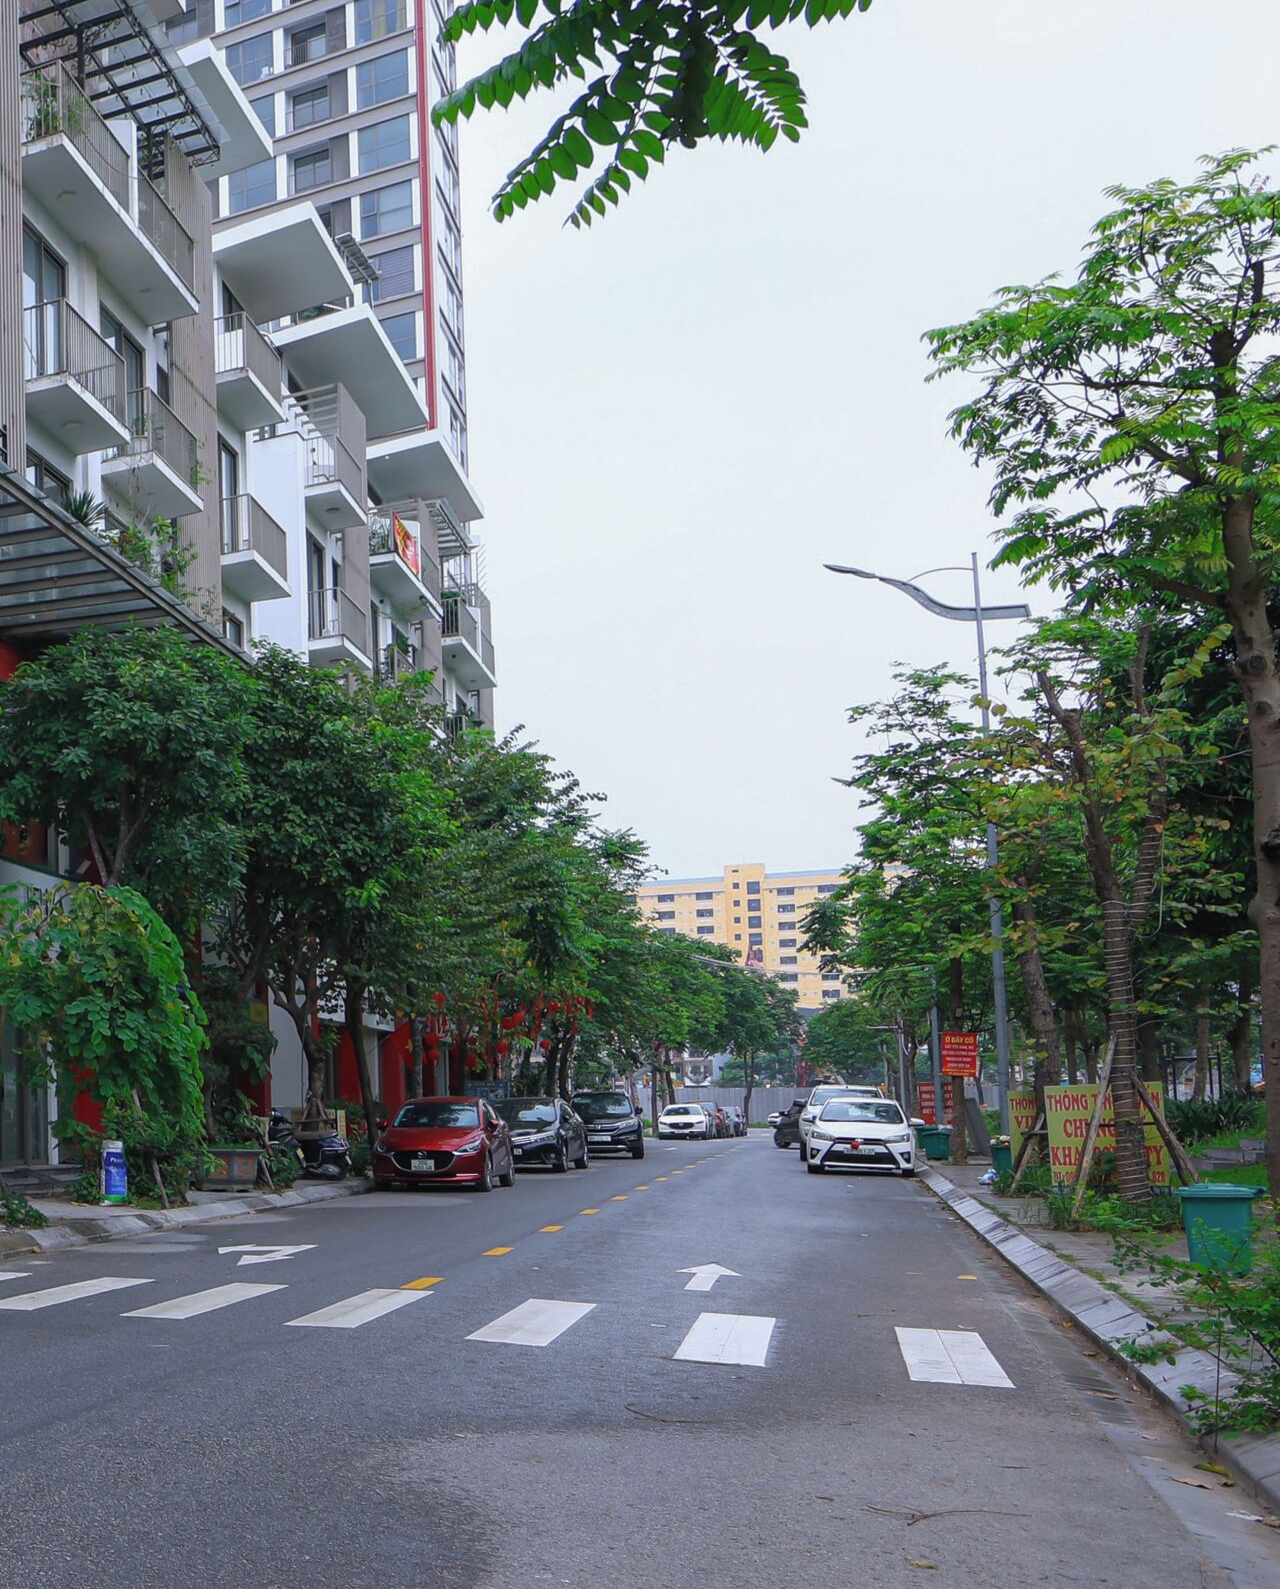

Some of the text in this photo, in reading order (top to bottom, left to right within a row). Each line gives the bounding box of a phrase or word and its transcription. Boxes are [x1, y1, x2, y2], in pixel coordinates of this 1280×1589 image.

[1009, 1095, 1039, 1112] THÔN
[1046, 1090, 1089, 1112] THÔNG
[1063, 1118, 1118, 1139] CHNG
